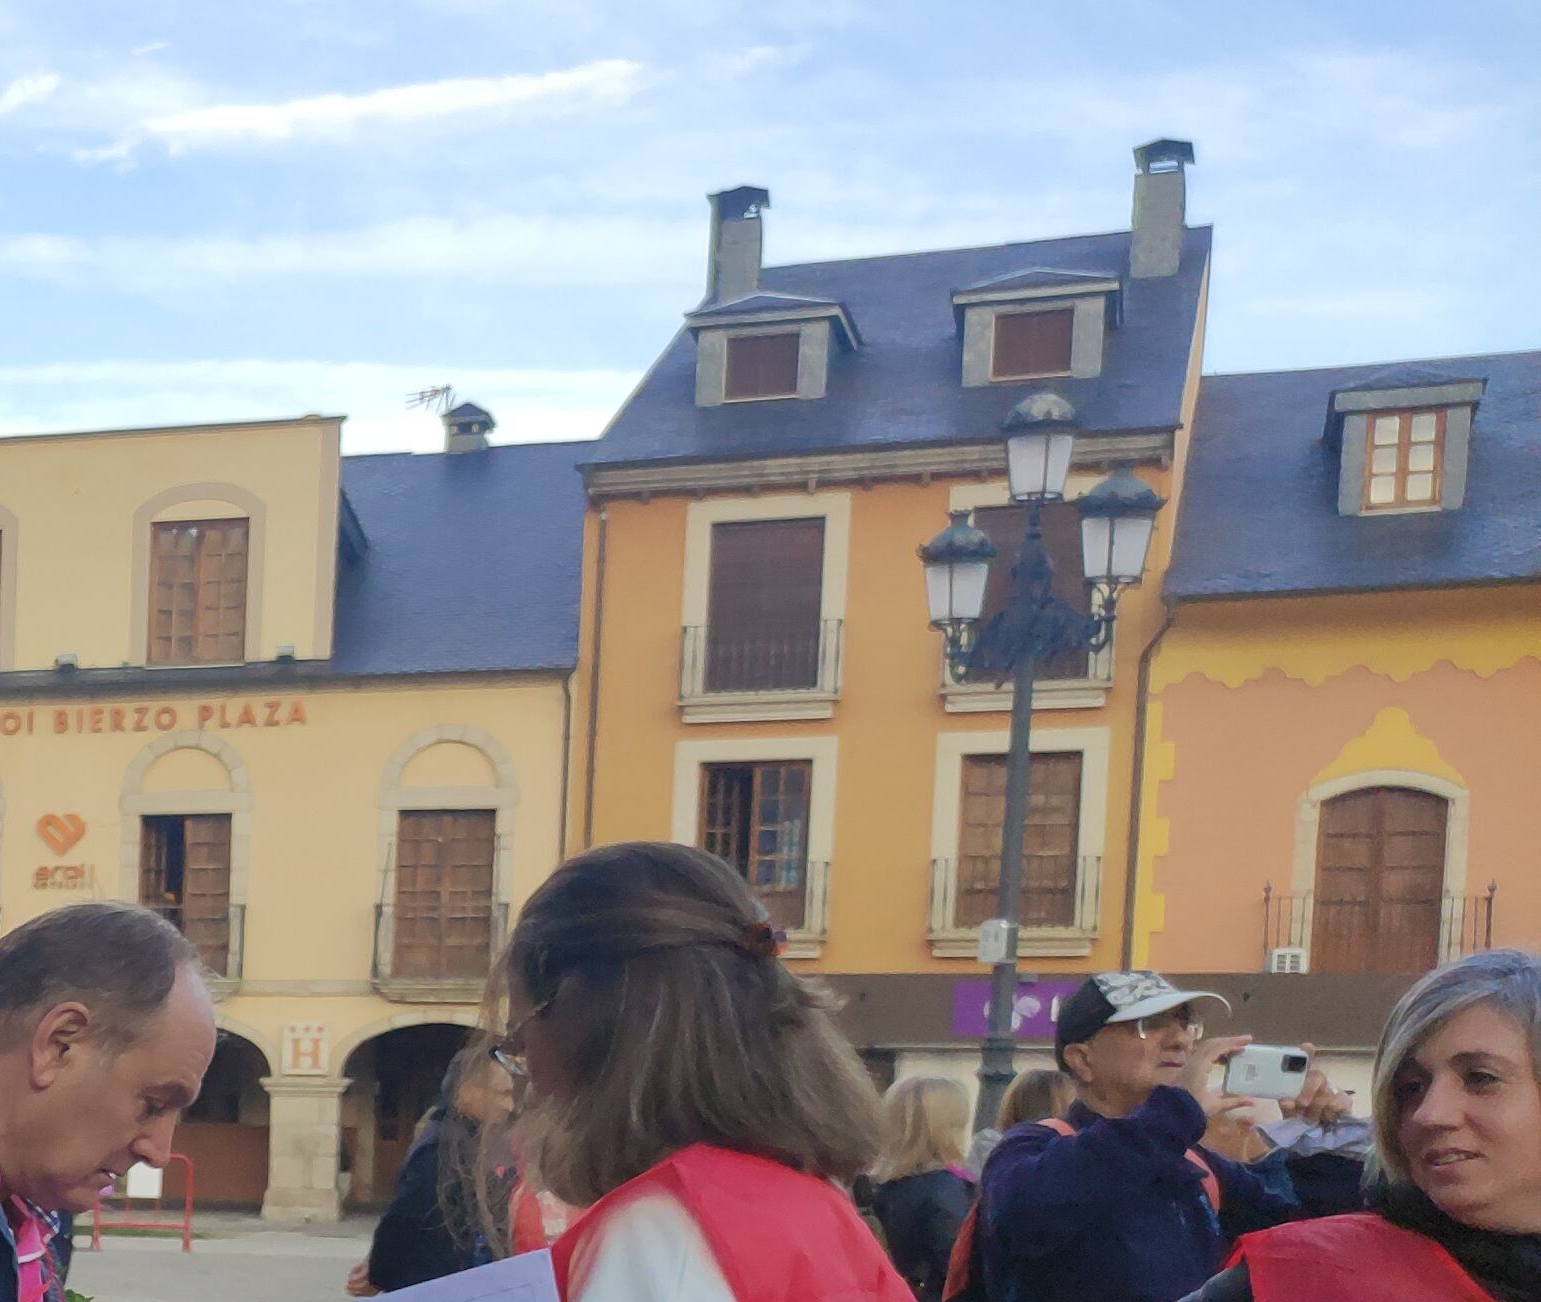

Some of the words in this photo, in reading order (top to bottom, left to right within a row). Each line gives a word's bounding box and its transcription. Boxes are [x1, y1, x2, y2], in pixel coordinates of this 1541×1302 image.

[52, 705, 178, 735] BIERZO
[197, 699, 309, 730] PLAZA
[291, 1037, 322, 1070] H
